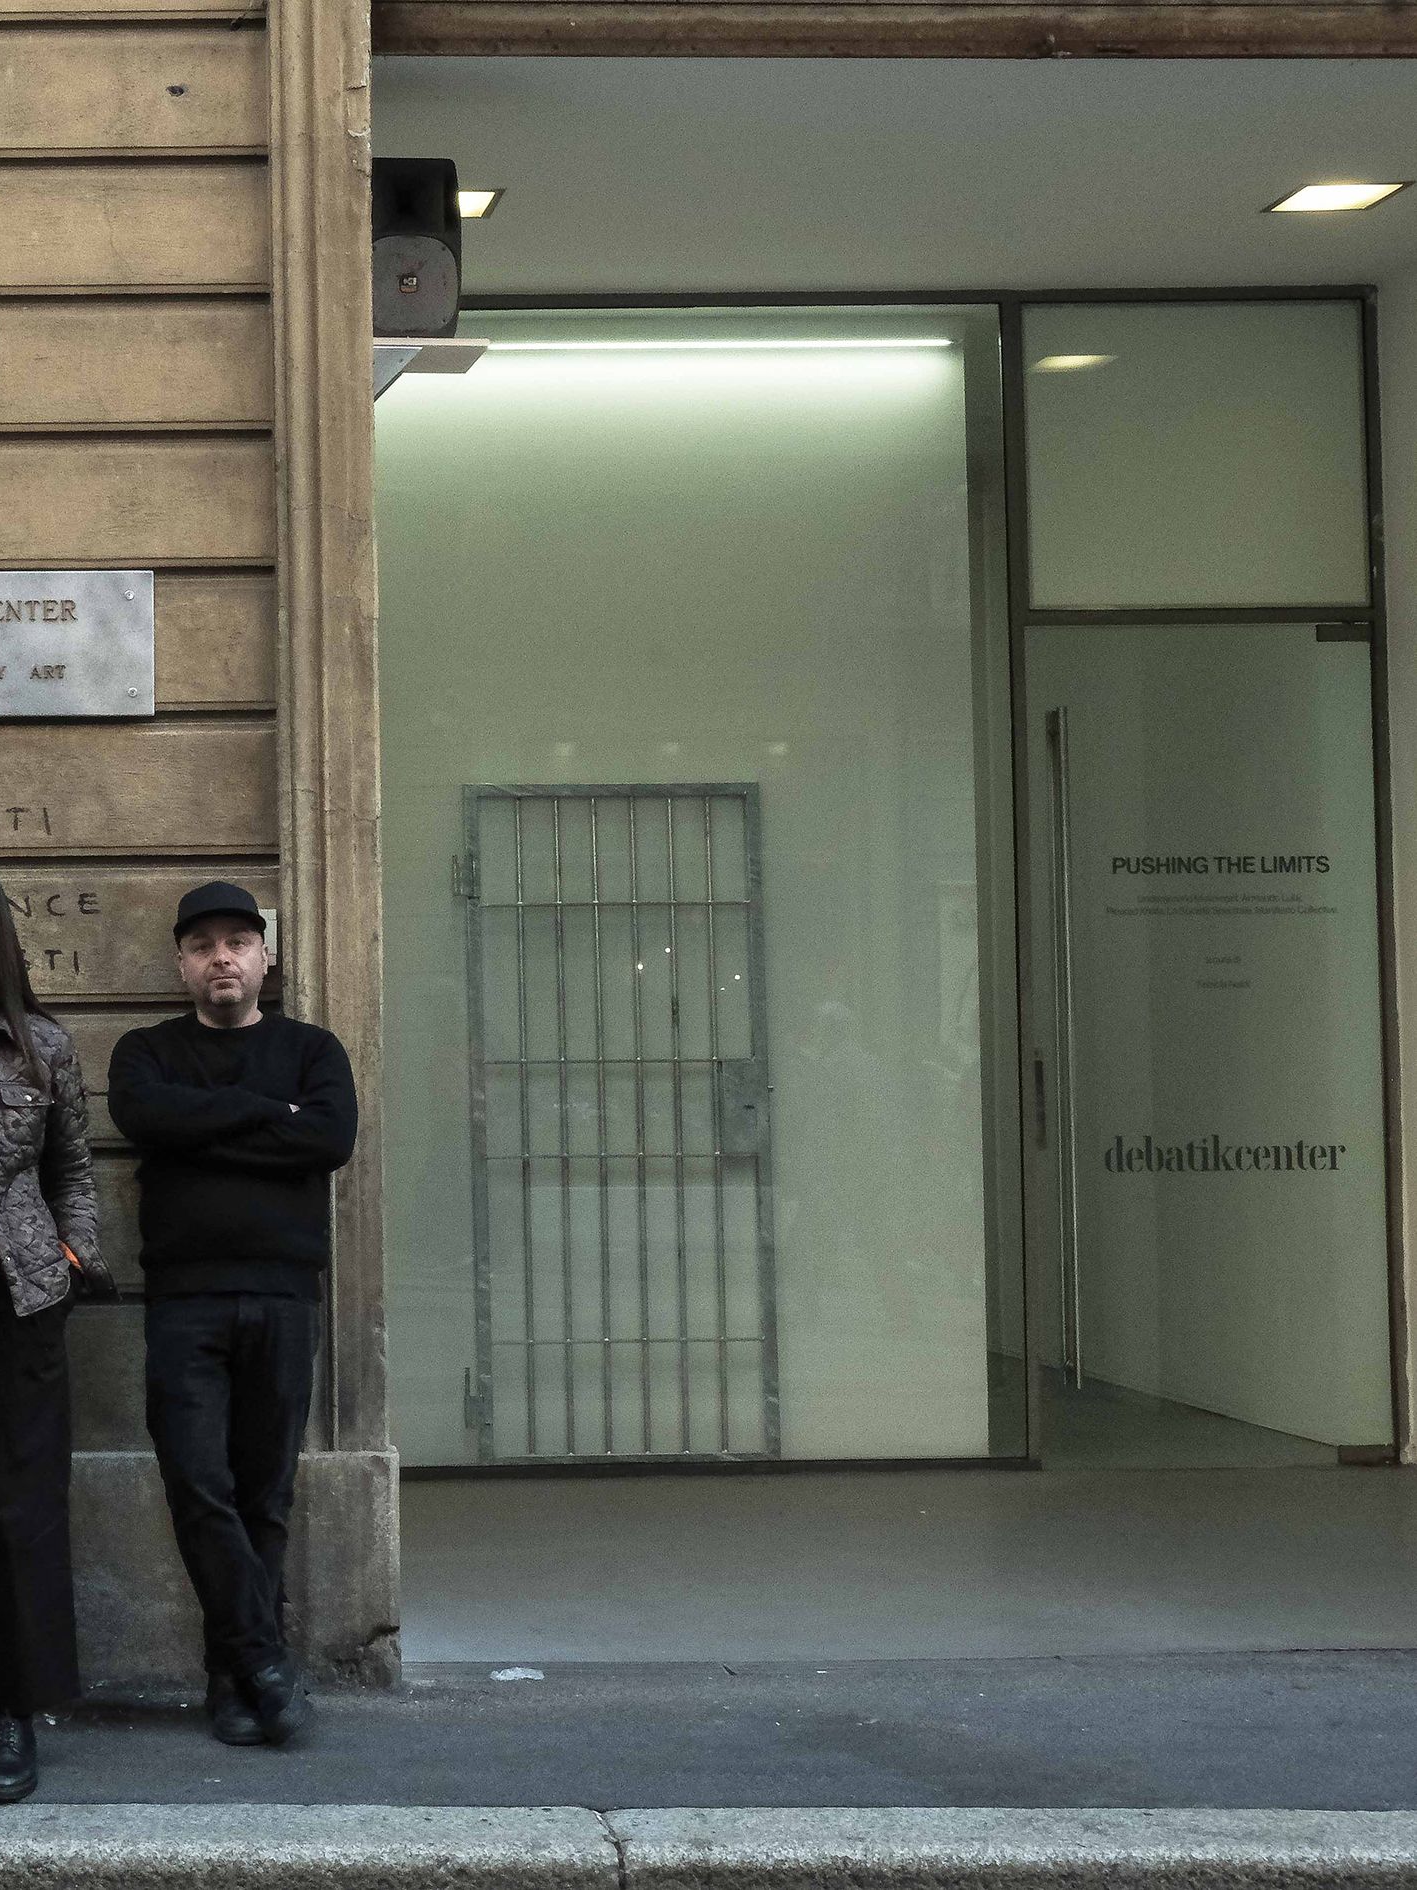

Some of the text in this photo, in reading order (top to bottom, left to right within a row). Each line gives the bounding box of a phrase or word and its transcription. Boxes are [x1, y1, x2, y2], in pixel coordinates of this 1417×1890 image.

[30, 664, 66, 681] ART
[1111, 855, 1331, 875] PUSHING THE LIMITS
[1104, 1134, 1347, 1173] debatikcenter
